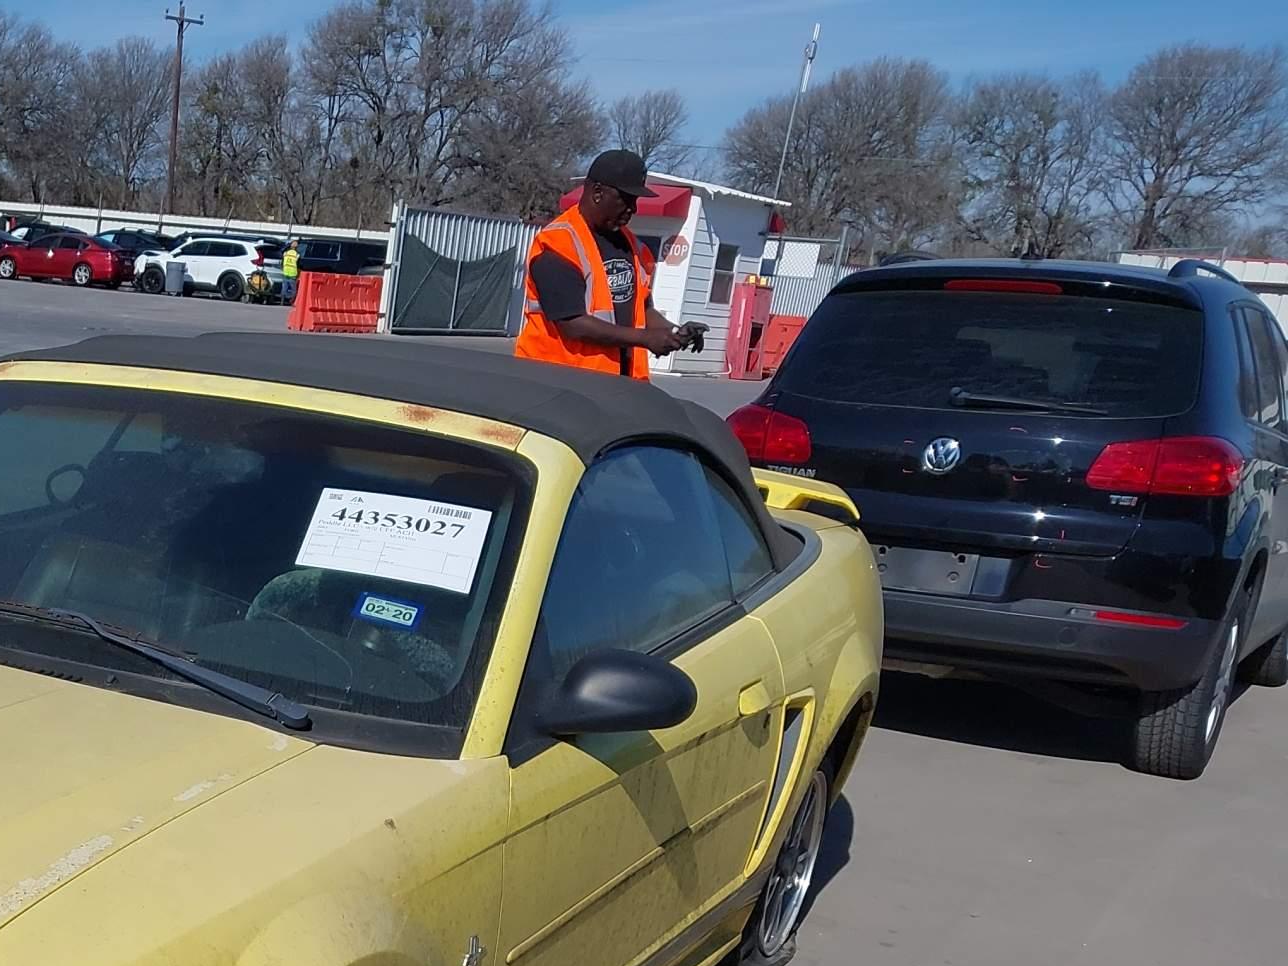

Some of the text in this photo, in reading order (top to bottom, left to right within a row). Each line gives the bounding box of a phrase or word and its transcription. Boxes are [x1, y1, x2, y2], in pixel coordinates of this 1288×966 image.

[663, 243, 688, 257] STOP
[331, 507, 466, 540] 44353027
[365, 602, 413, 621] 02 20
